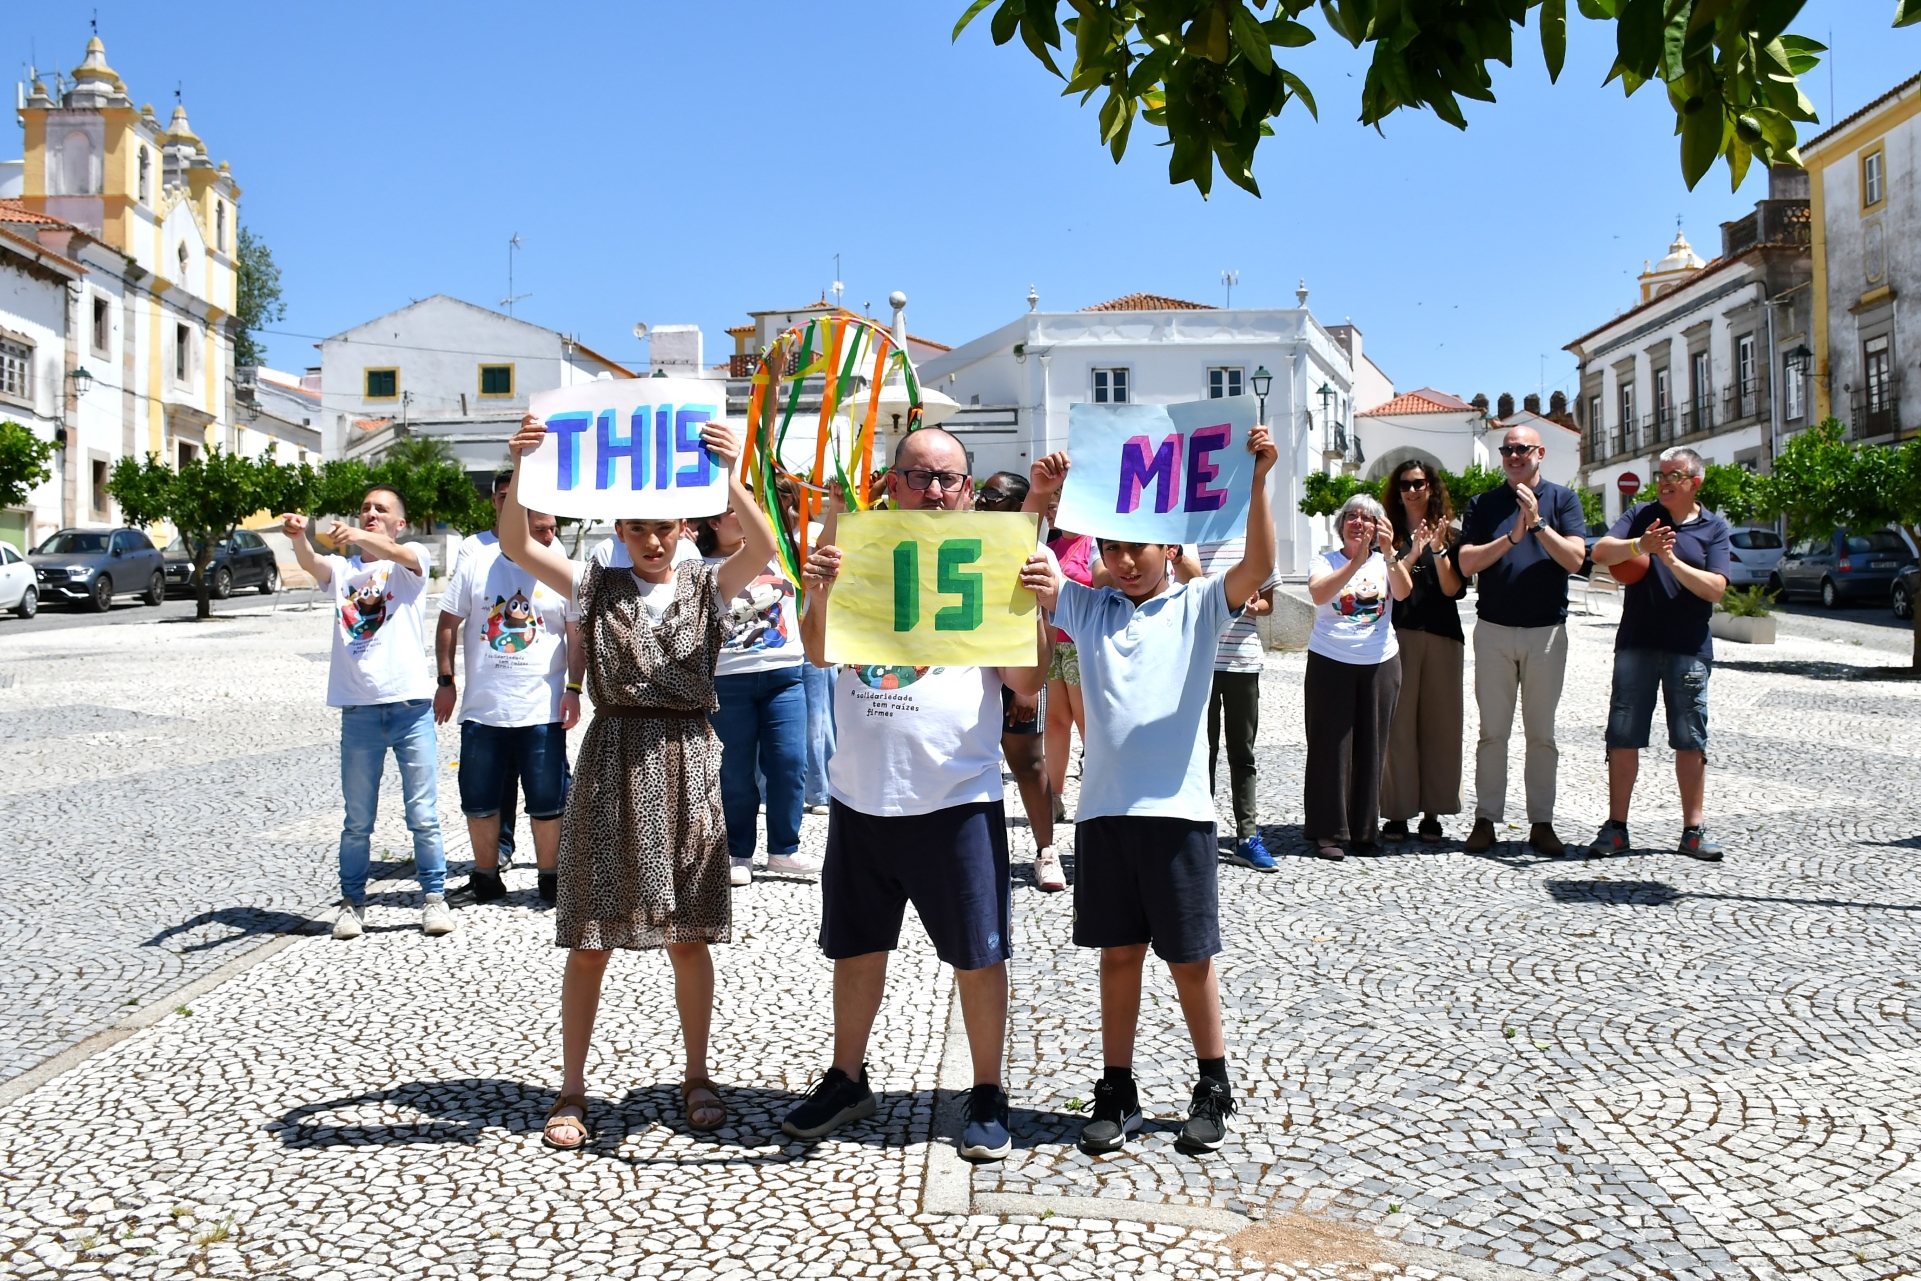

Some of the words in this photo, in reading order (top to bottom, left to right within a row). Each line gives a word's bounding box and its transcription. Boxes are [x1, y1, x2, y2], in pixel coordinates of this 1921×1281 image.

[545, 403, 720, 491] THIS
[1116, 423, 1231, 514] ME
[893, 539, 983, 632] IS
[856, 692, 912, 701] solidariedade
[866, 708, 894, 717] firmes
[891, 702, 920, 712] raízes
